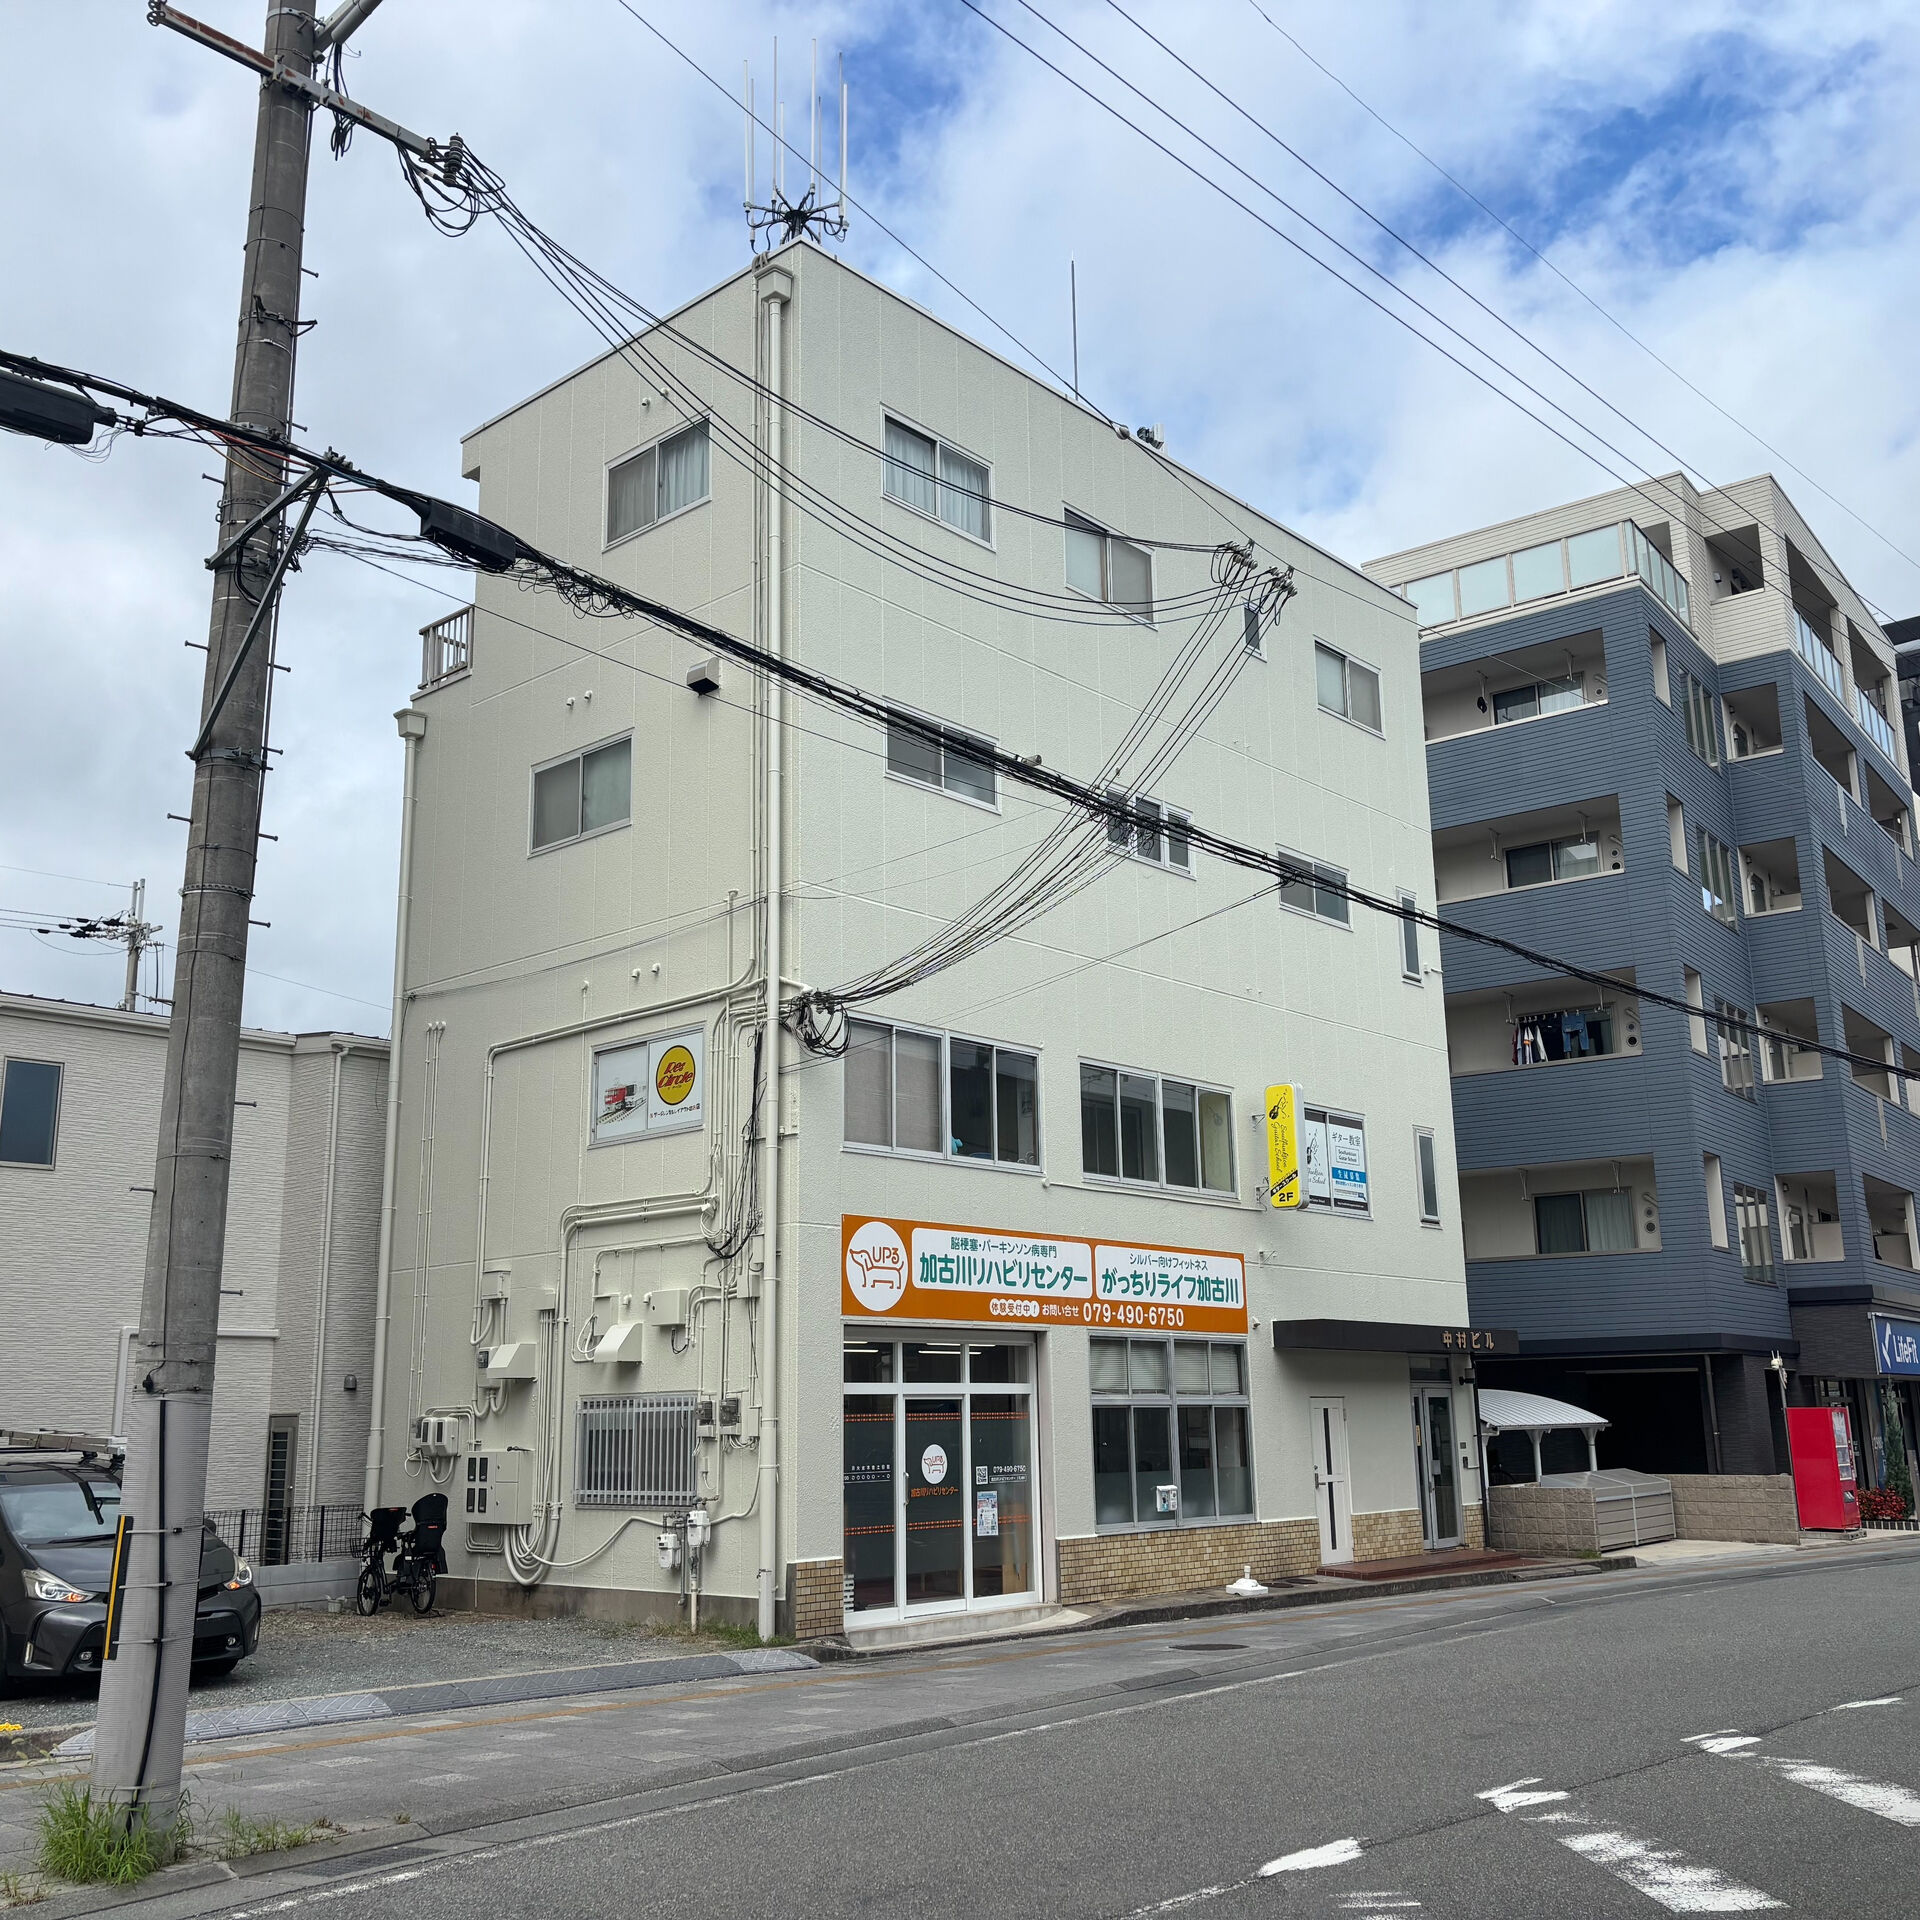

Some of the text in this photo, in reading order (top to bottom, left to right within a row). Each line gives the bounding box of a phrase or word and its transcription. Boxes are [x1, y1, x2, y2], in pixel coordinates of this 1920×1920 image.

[1332, 1131, 1361, 1147] ギター教室
[1278, 1192, 1294, 1202] 2F
[919, 1252, 1088, 1291] 加古川リハビリセンター
[1129, 1253, 1209, 1271] シルバー向けフィットネス
[1101, 1267, 1239, 1304] がっちりライフ加古川
[1042, 1304, 1079, 1317] お問い合せ
[1083, 1302, 1185, 1327] 079-490-6750
[1442, 1330, 1495, 1350] 中村ビル
[1892, 1335, 1919, 1364] LifeFit
[911, 1486, 959, 1498] 加古川リハビリセンター
